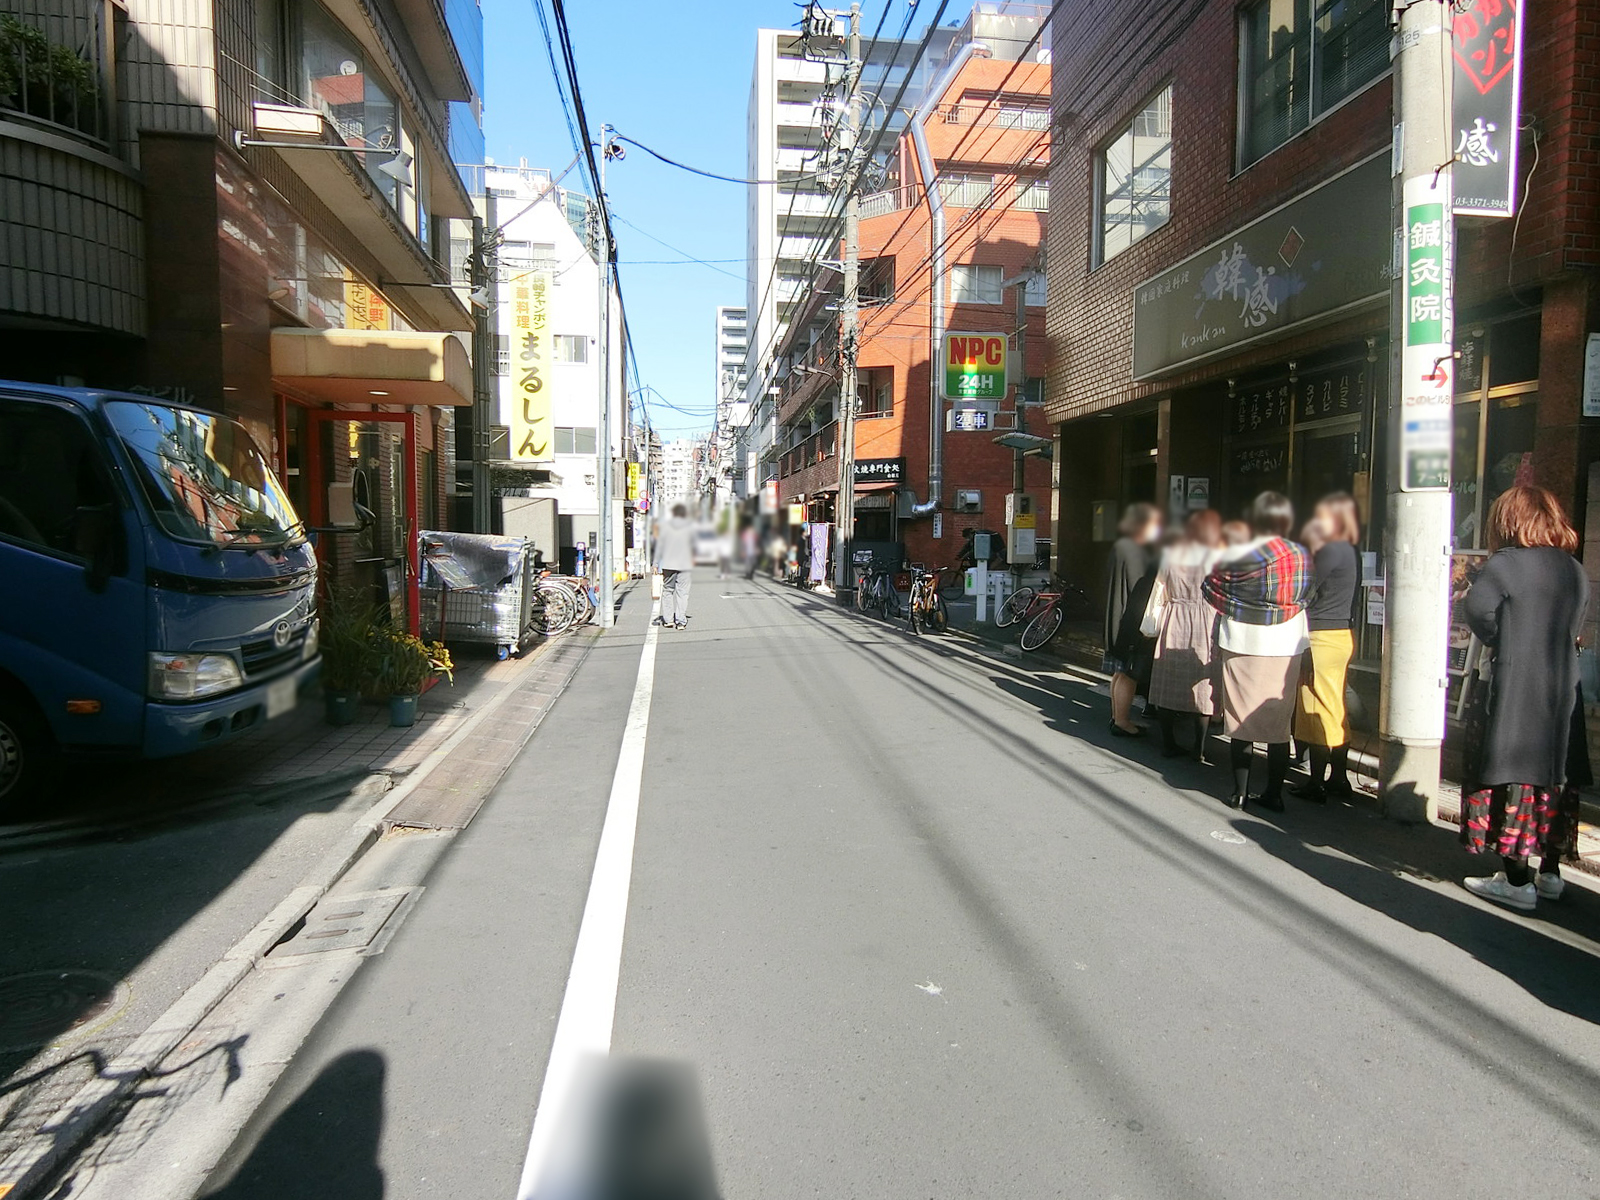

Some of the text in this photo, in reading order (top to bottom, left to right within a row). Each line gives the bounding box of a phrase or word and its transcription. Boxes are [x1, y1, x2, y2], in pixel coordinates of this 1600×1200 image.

[1455, 117, 1498, 166] 感
[1410, 221, 1440, 323] 鍼灸院
[949, 337, 1002, 365] NPC
[518, 332, 547, 456] まるしん
[958, 374, 993, 389] 24H
[955, 412, 987, 429] 空車
